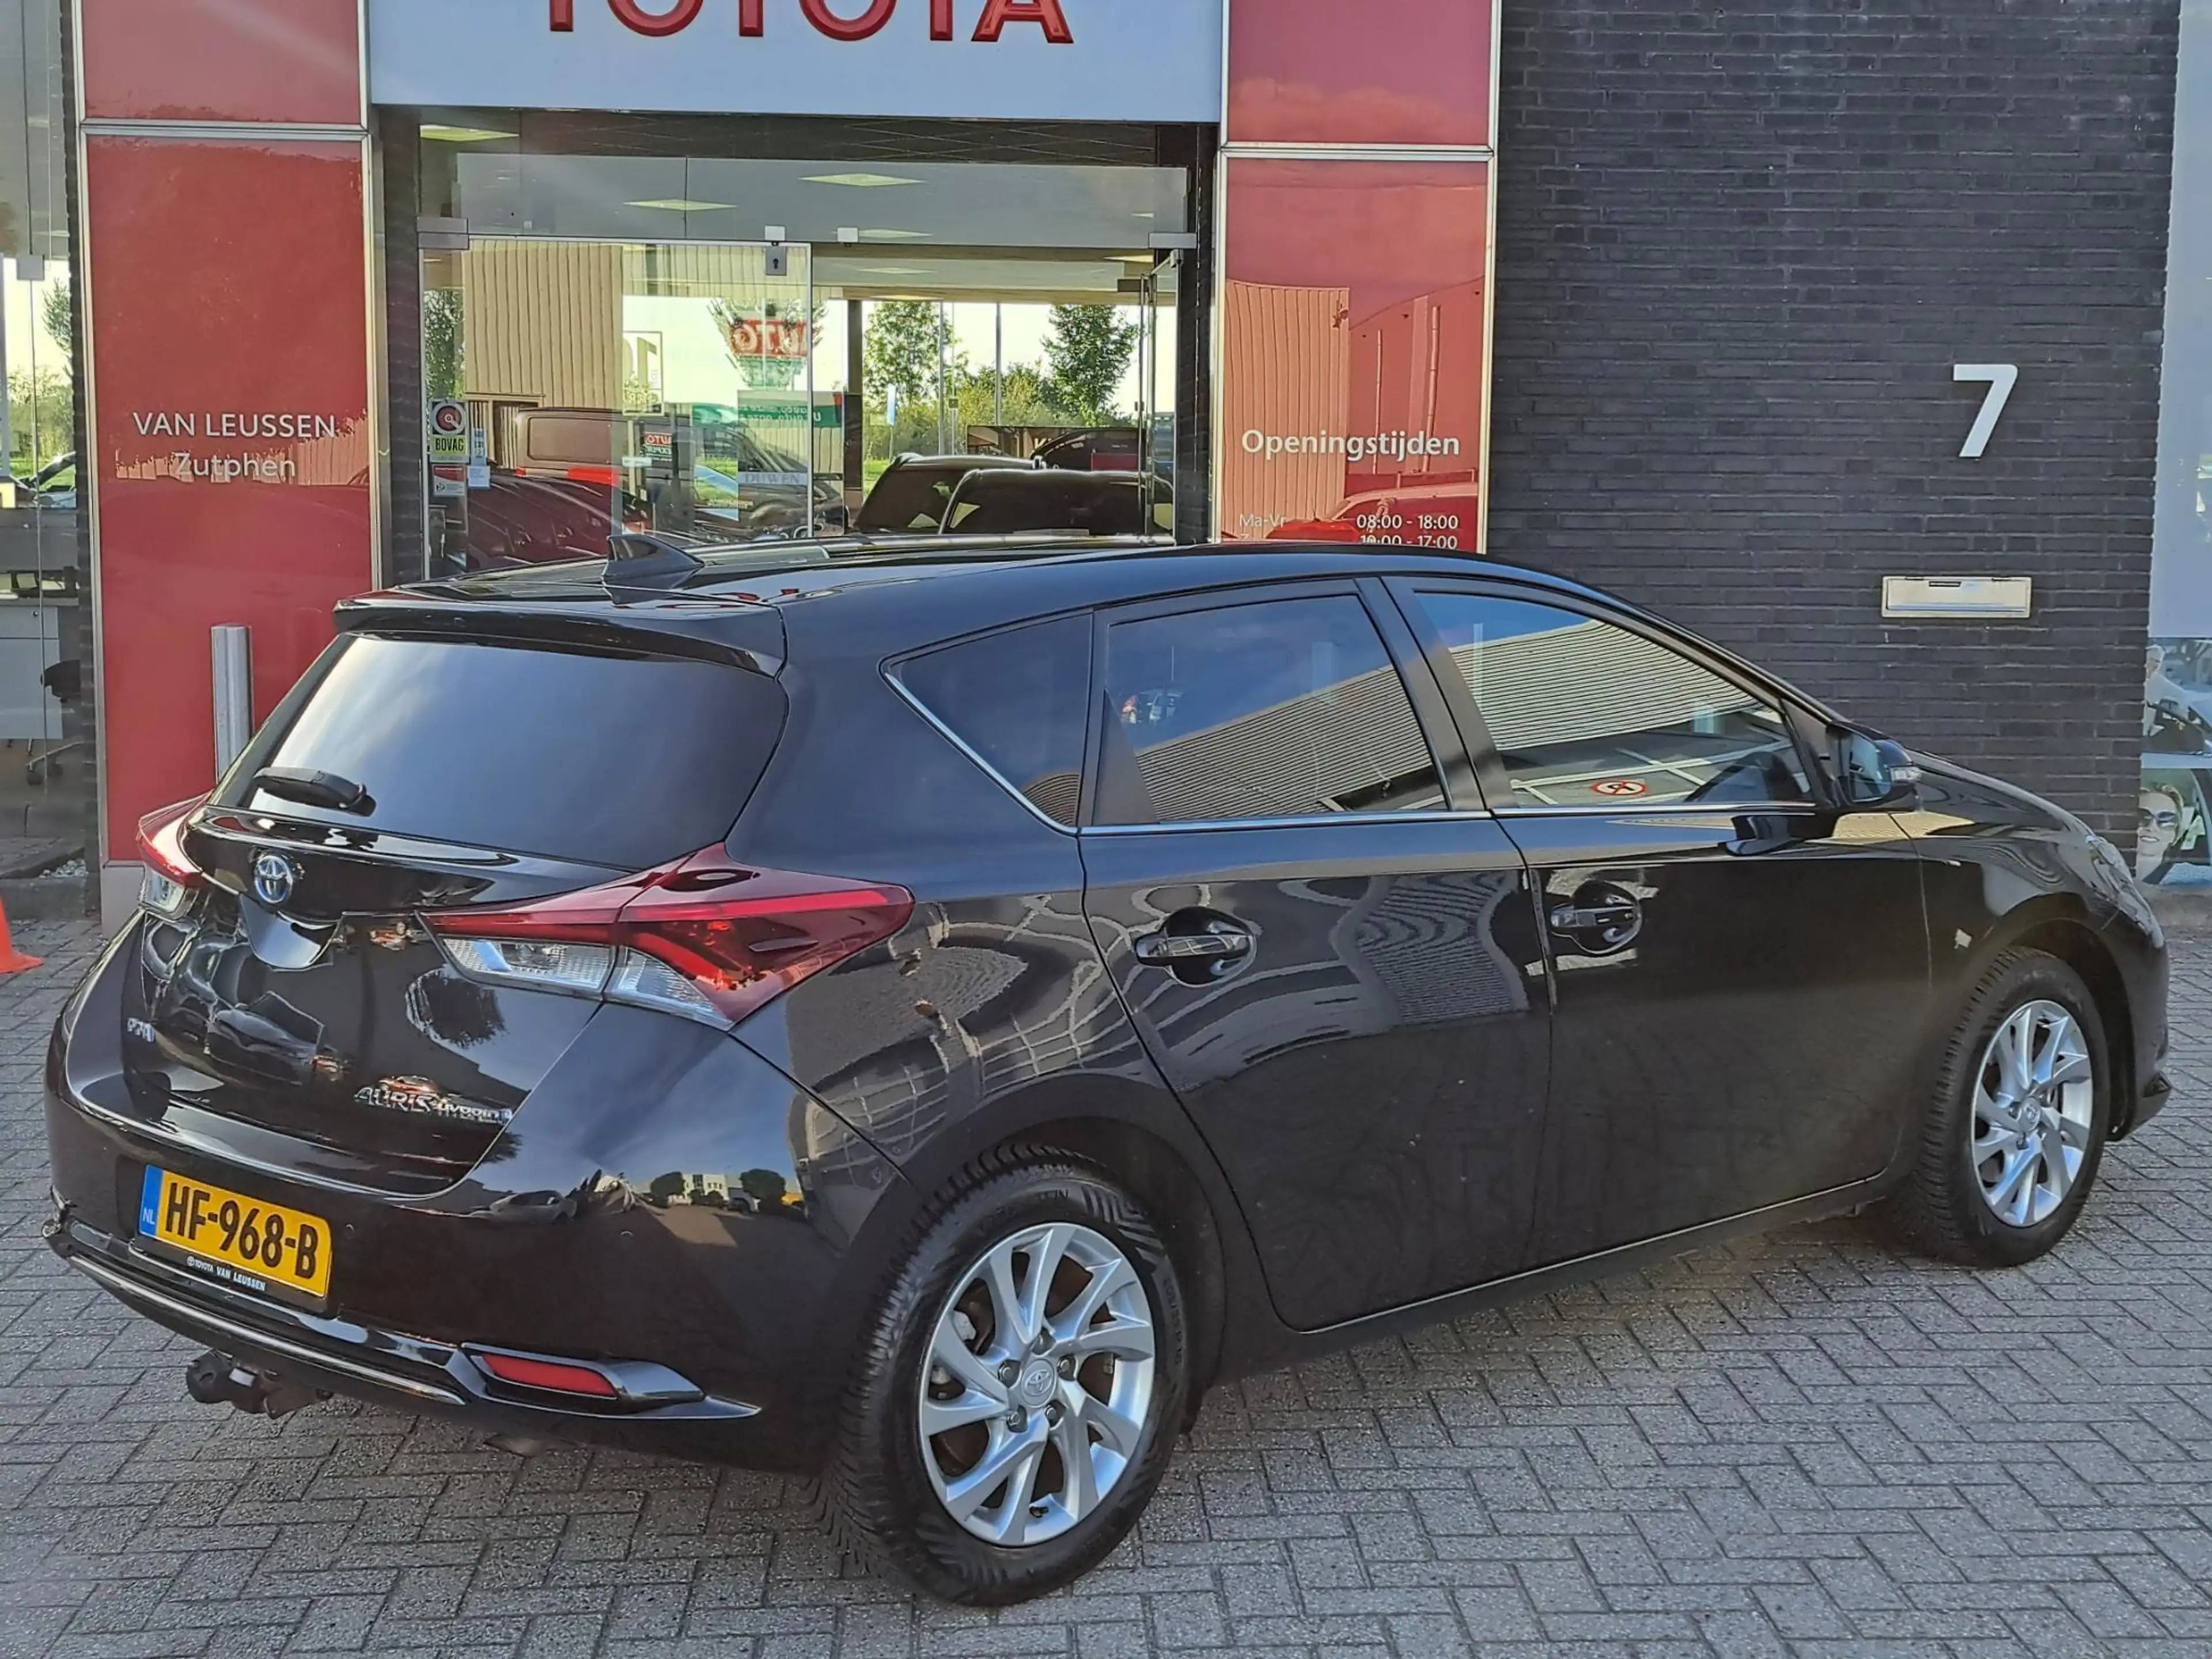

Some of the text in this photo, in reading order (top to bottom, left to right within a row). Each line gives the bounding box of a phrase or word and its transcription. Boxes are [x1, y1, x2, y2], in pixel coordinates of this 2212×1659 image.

[1953, 363, 2018, 457] 7
[132, 412, 335, 438] VAN LEUSSEN
[435, 437, 464, 452] BOVAG
[1241, 429, 1460, 461] Openingstijden
[175, 452, 297, 483] Zutphen
[1357, 514, 1402, 529] 08:00
[1417, 514, 1459, 529] 18:00
[354, 1087, 431, 1113] AURIS
[142, 1207, 155, 1225] NL
[165, 1182, 319, 1280] HF-968-B
[195, 1259, 266, 1291] TOYOTA VAN LEUSSEN
